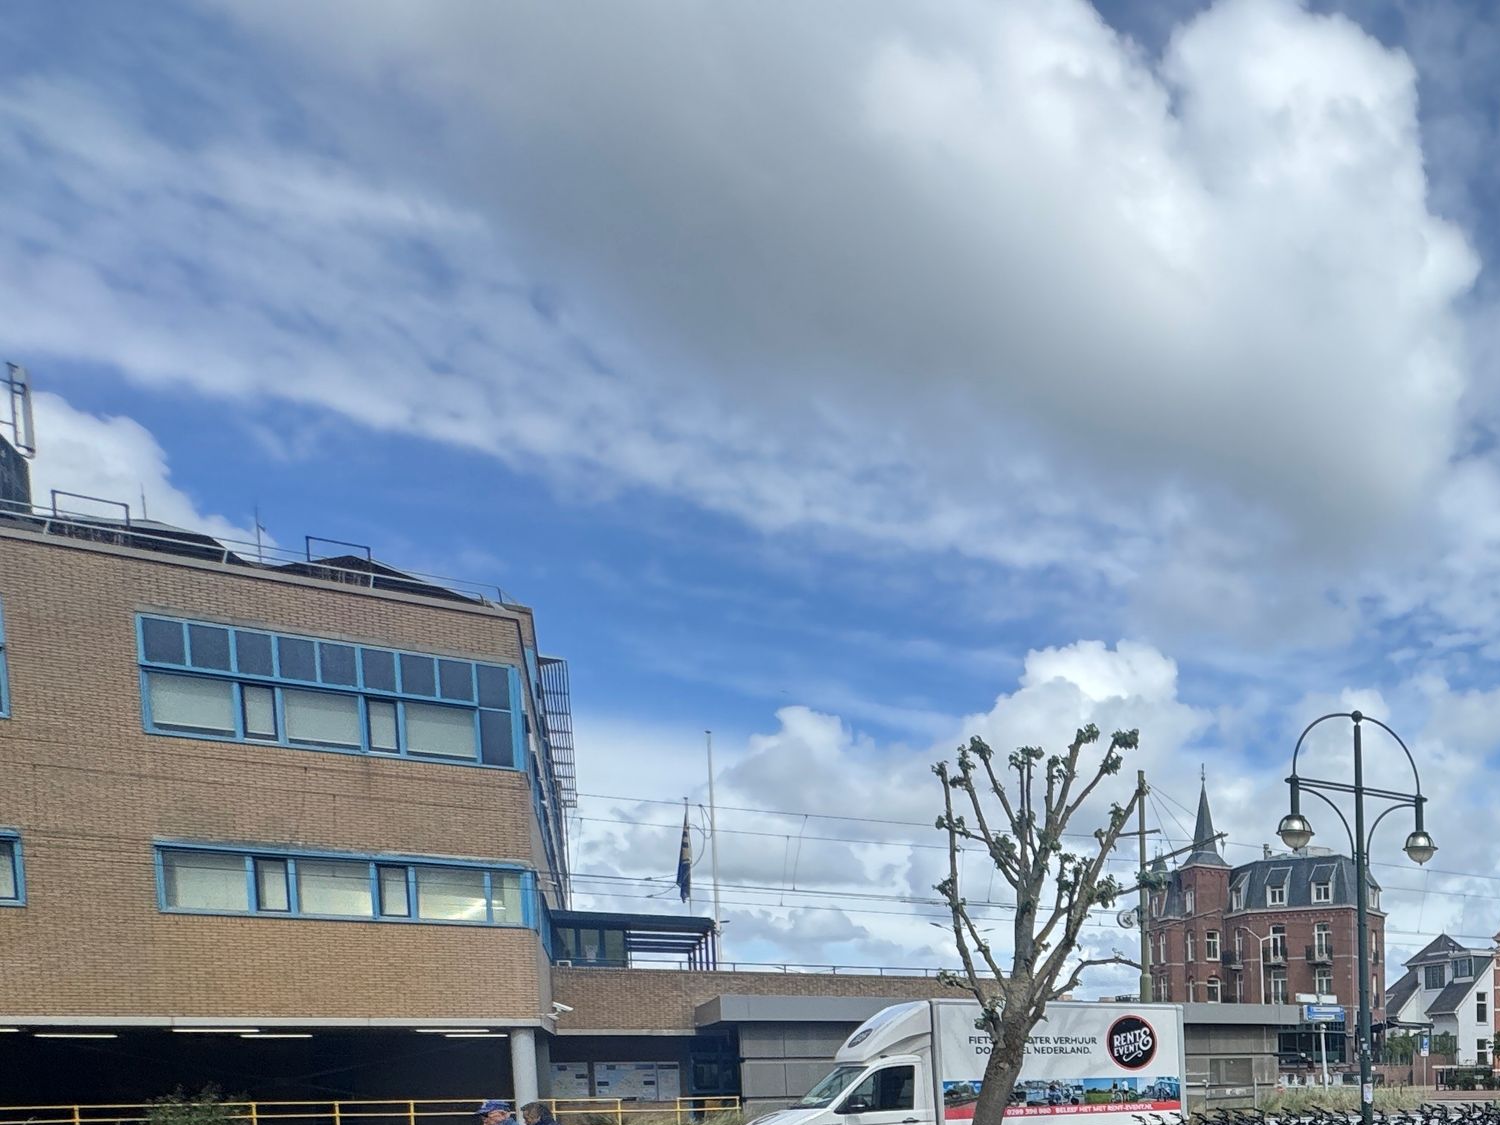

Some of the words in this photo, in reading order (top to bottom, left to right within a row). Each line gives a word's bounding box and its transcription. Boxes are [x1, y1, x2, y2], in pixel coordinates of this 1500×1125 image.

[1053, 1036, 1098, 1045] VERHUUR
[1113, 1030, 1140, 1047] RENT
[1140, 1027, 1153, 1051] &
[1034, 1046, 1093, 1055] NEDERLAND.
[1114, 1043, 1139, 1057] EVENT
